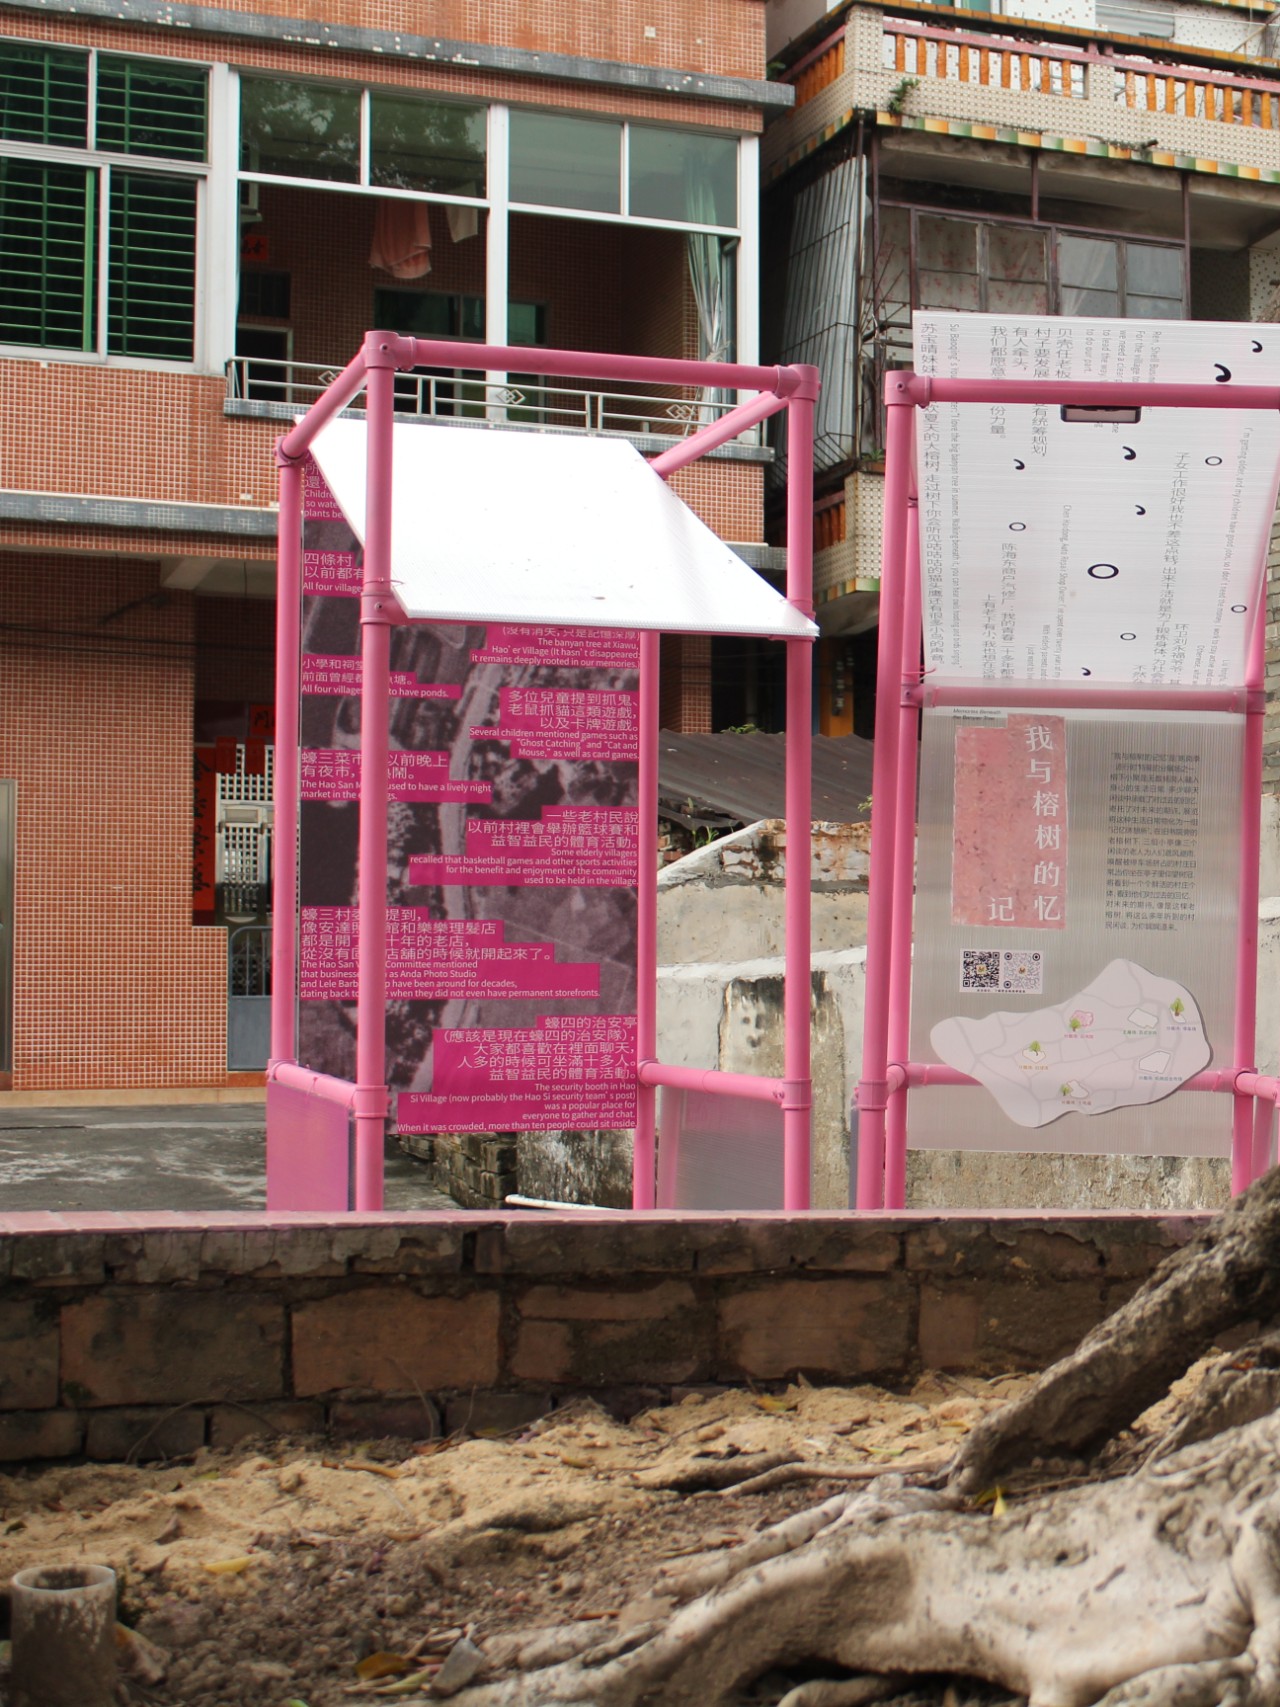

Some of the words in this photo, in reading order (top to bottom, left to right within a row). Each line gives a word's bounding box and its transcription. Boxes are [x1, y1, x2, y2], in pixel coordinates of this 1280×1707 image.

[304, 553, 353, 567] 四條村
[303, 582, 313, 590] All
[316, 582, 332, 590] four
[335, 584, 363, 594] village
[555, 639, 584, 648] banyan
[522, 647, 549, 656] Village
[478, 656, 513, 665] remains
[513, 656, 542, 666] deeply
[302, 684, 312, 693] All
[314, 685, 332, 693] four
[469, 727, 499, 737] Several
[501, 729, 534, 739] children
[564, 748, 581, 757] well
[301, 780, 317, 788] The
[447, 784, 468, 793] lively
[470, 784, 491, 793] night
[576, 849, 603, 858] elderly
[604, 849, 637, 859] villagers
[602, 858, 637, 866] activities
[301, 990, 328, 999] dating
[415, 990, 433, 999] they
[552, 1084, 583, 1092] security
[420, 1095, 447, 1104] Village
[472, 1094, 508, 1103] probably
[569, 1102, 600, 1110] popular
[602, 1102, 623, 1110] place
[572, 1111, 597, 1120] gather
[397, 1124, 421, 1132] When
[547, 1121, 575, 1130] people
[576, 1120, 600, 1130] could
